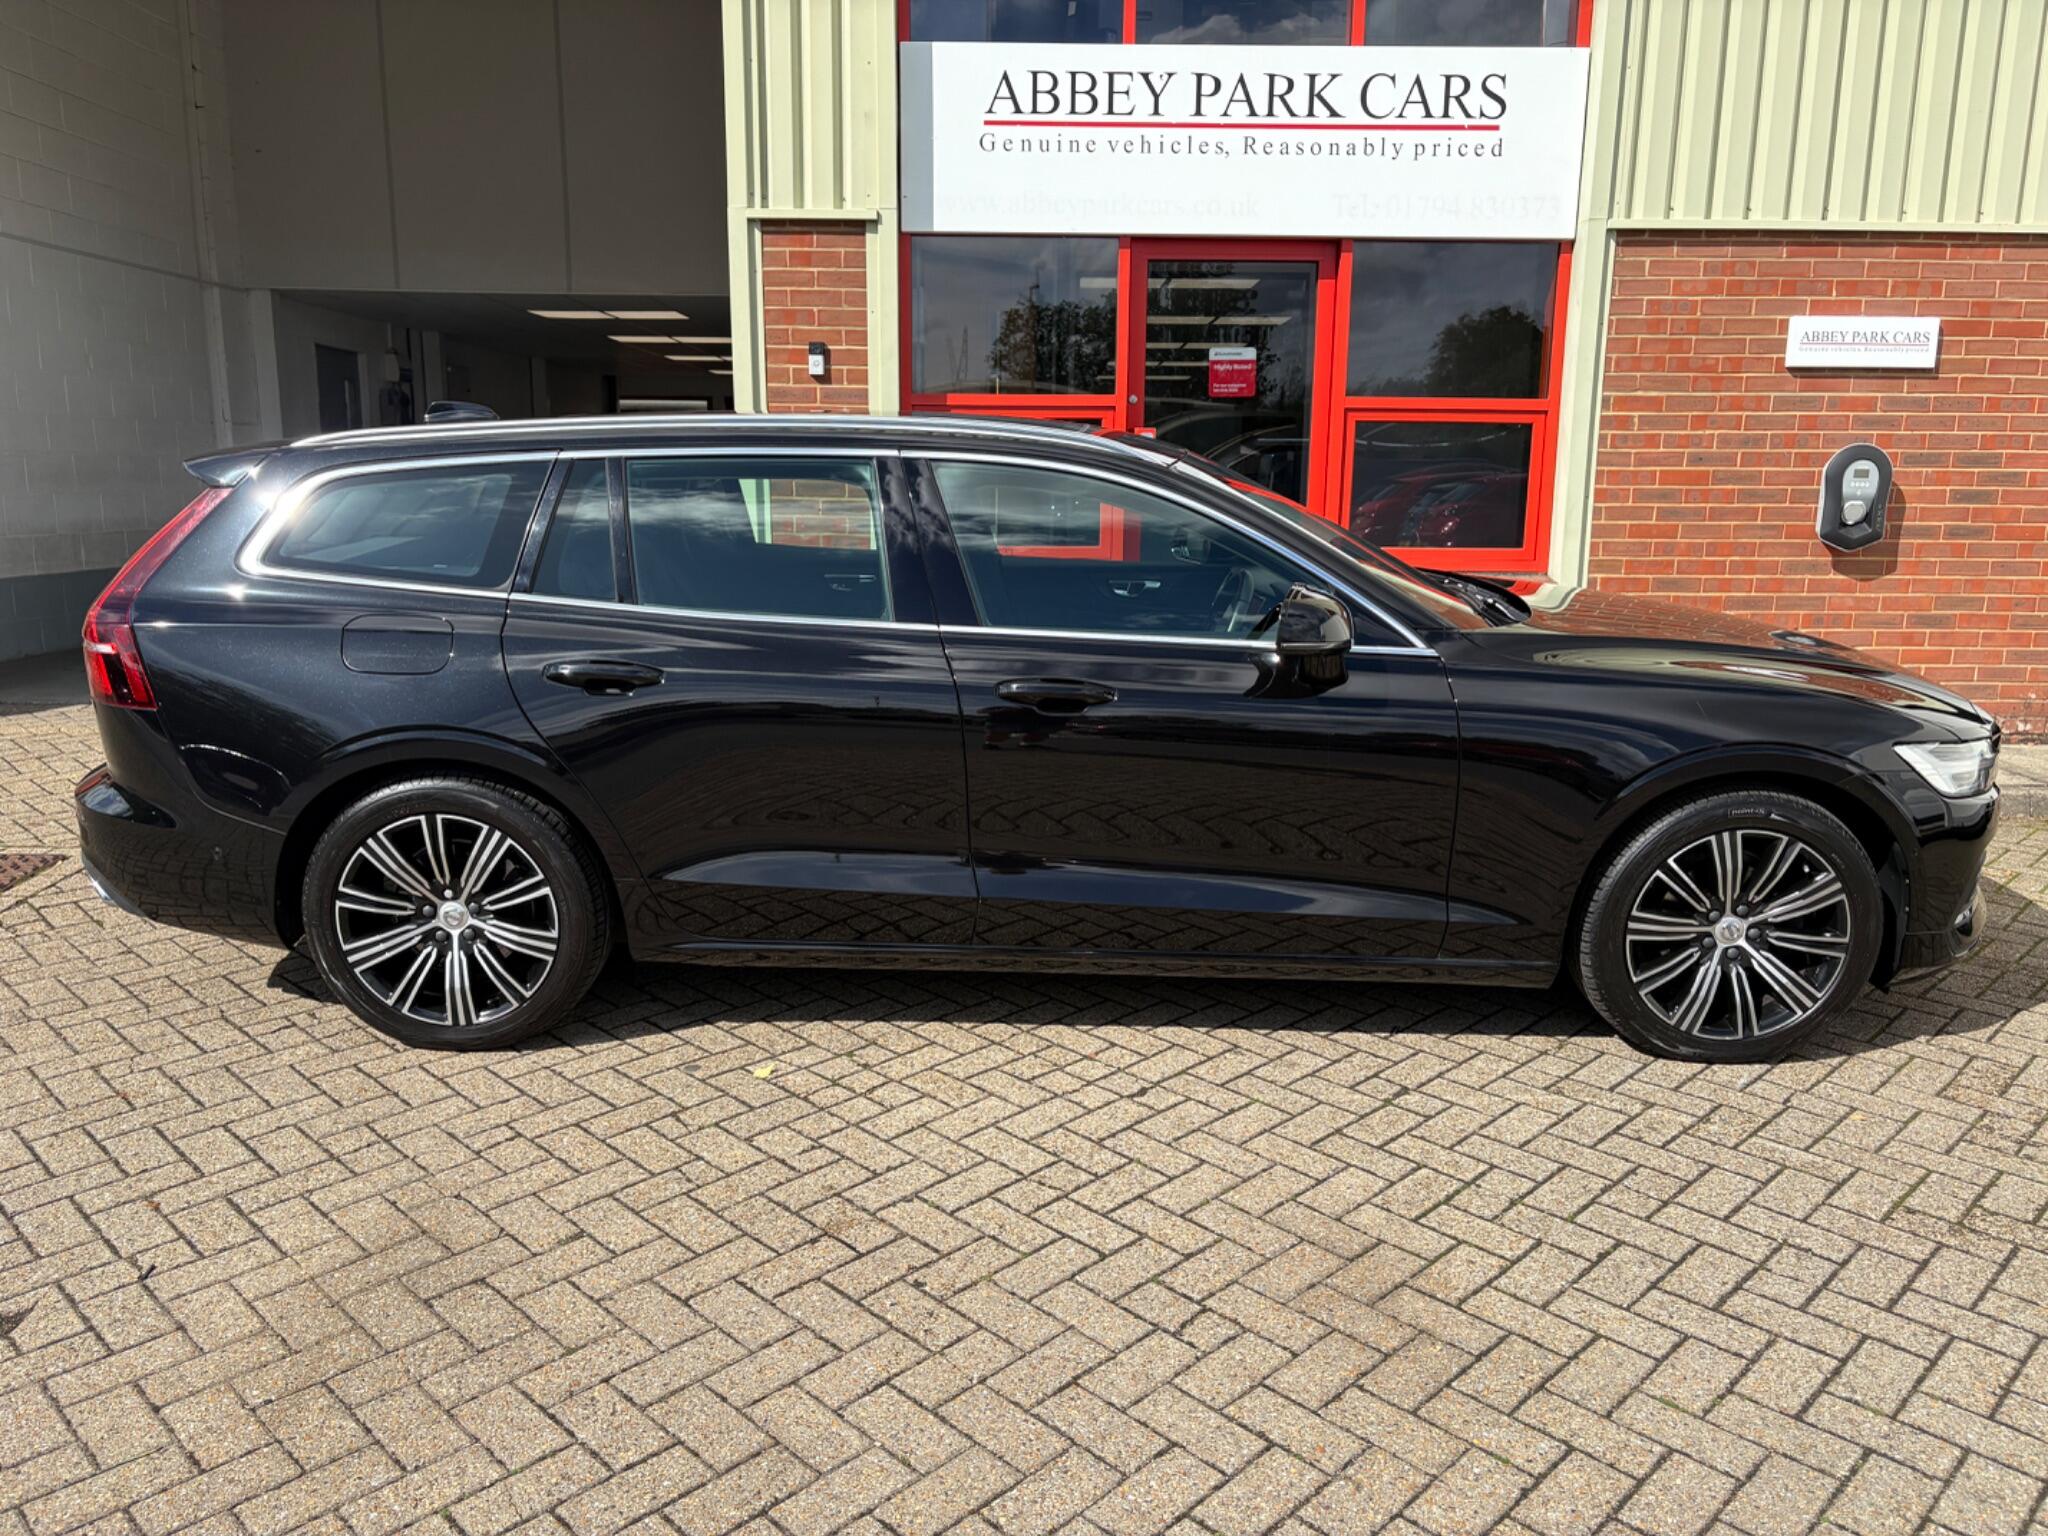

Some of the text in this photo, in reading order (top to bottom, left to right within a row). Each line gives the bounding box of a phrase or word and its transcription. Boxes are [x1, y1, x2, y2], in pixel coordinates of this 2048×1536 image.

[984, 69, 1508, 120] ABBEY PARK CARS
[979, 132, 1504, 161] Genuine vehicles, Reasonably priced
[1800, 329, 1931, 344] ABBEY PARK CARS
